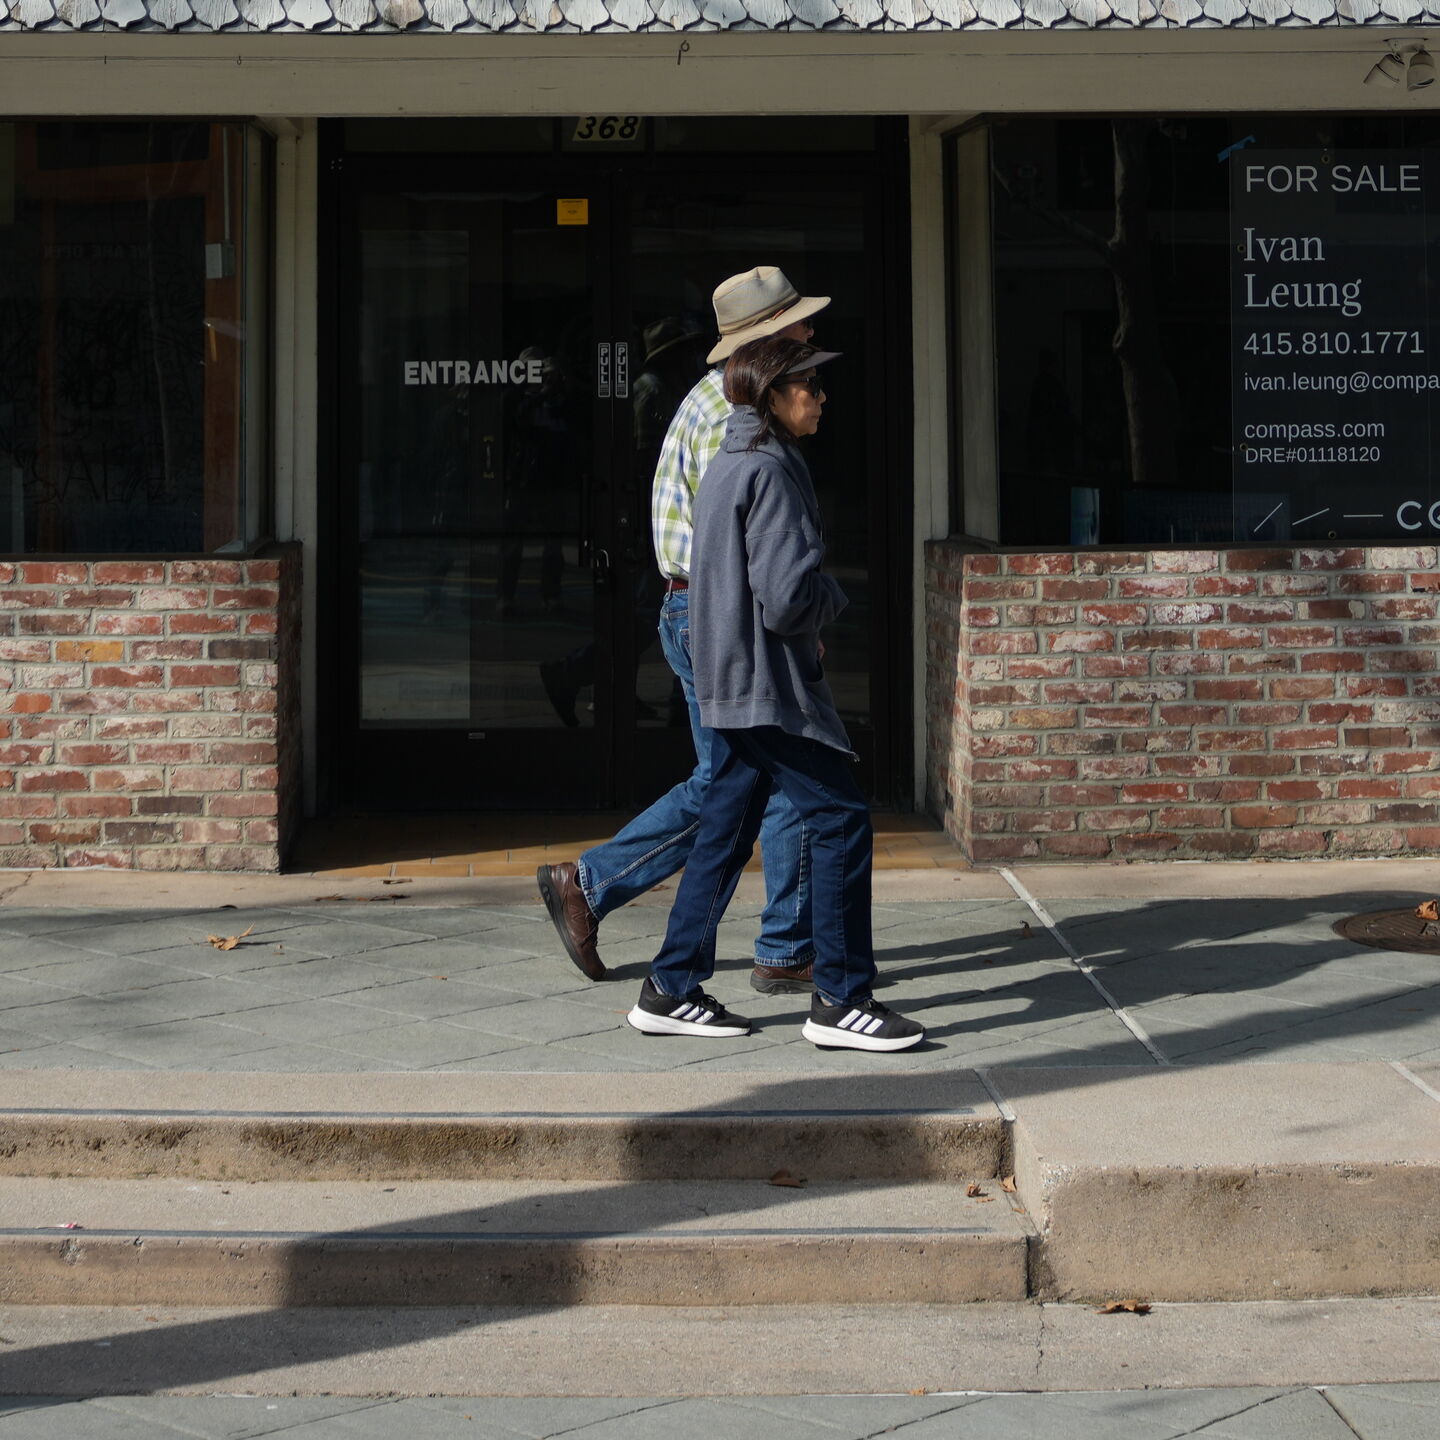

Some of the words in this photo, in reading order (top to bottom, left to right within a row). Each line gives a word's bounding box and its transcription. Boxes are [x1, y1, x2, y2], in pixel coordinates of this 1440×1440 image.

[577, 116, 639, 139] 368
[1246, 165, 1319, 193] FOR
[1330, 164, 1421, 192] SALE
[1244, 228, 1325, 262] Ivan
[1244, 273, 1362, 317] Leung
[1243, 331, 1425, 355] 415.810.1771
[404, 360, 542, 385] ENTRANCE
[600, 347, 608, 384] PULL
[617, 347, 625, 383] PULL
[1244, 421, 1385, 441] compass.com
[1245, 446, 1381, 463] DRE#01118120
